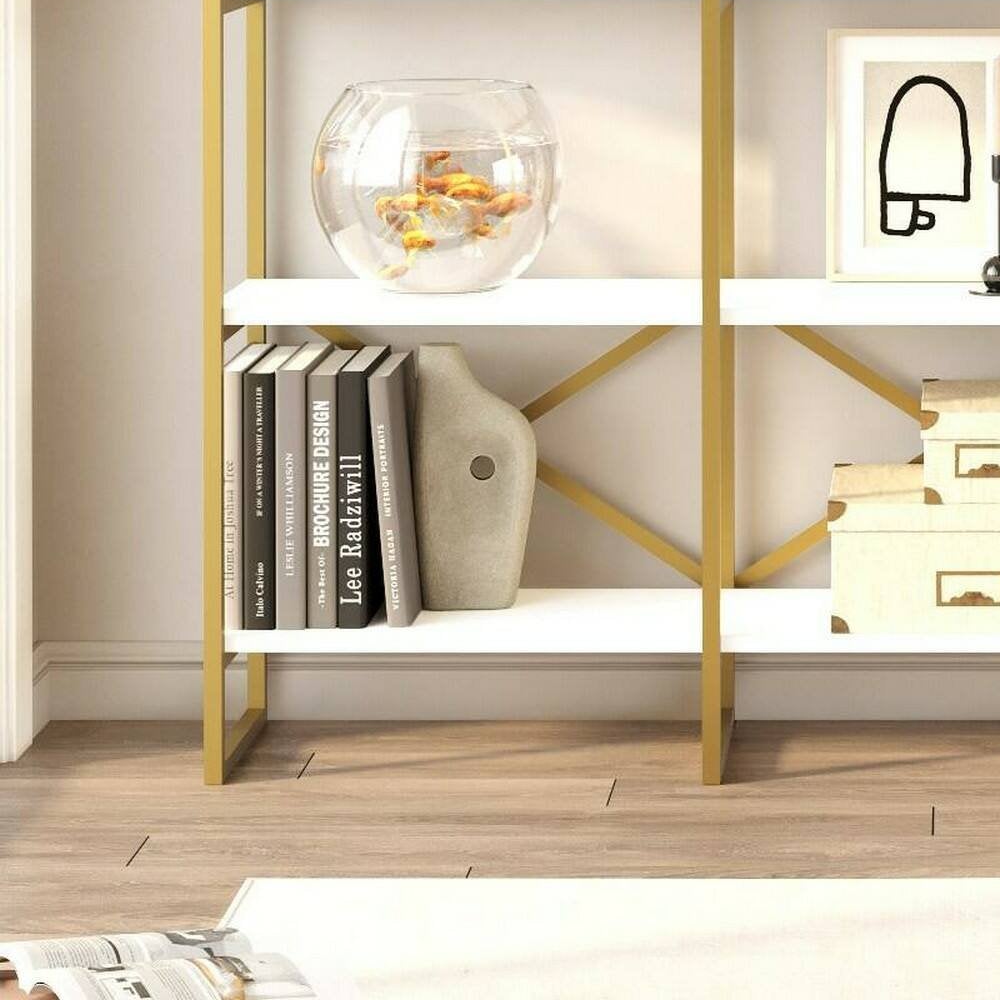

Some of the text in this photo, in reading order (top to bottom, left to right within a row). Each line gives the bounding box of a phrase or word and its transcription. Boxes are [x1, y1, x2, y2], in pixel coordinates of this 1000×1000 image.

[313, 400, 330, 548] BROCHURE DESIGN
[376, 423, 391, 517] INTERIOR PORTRAITS
[339, 454, 362, 607] Lee Radziwill
[255, 561, 264, 619] Italo Calvino
[388, 563, 399, 610] VICTORIA
